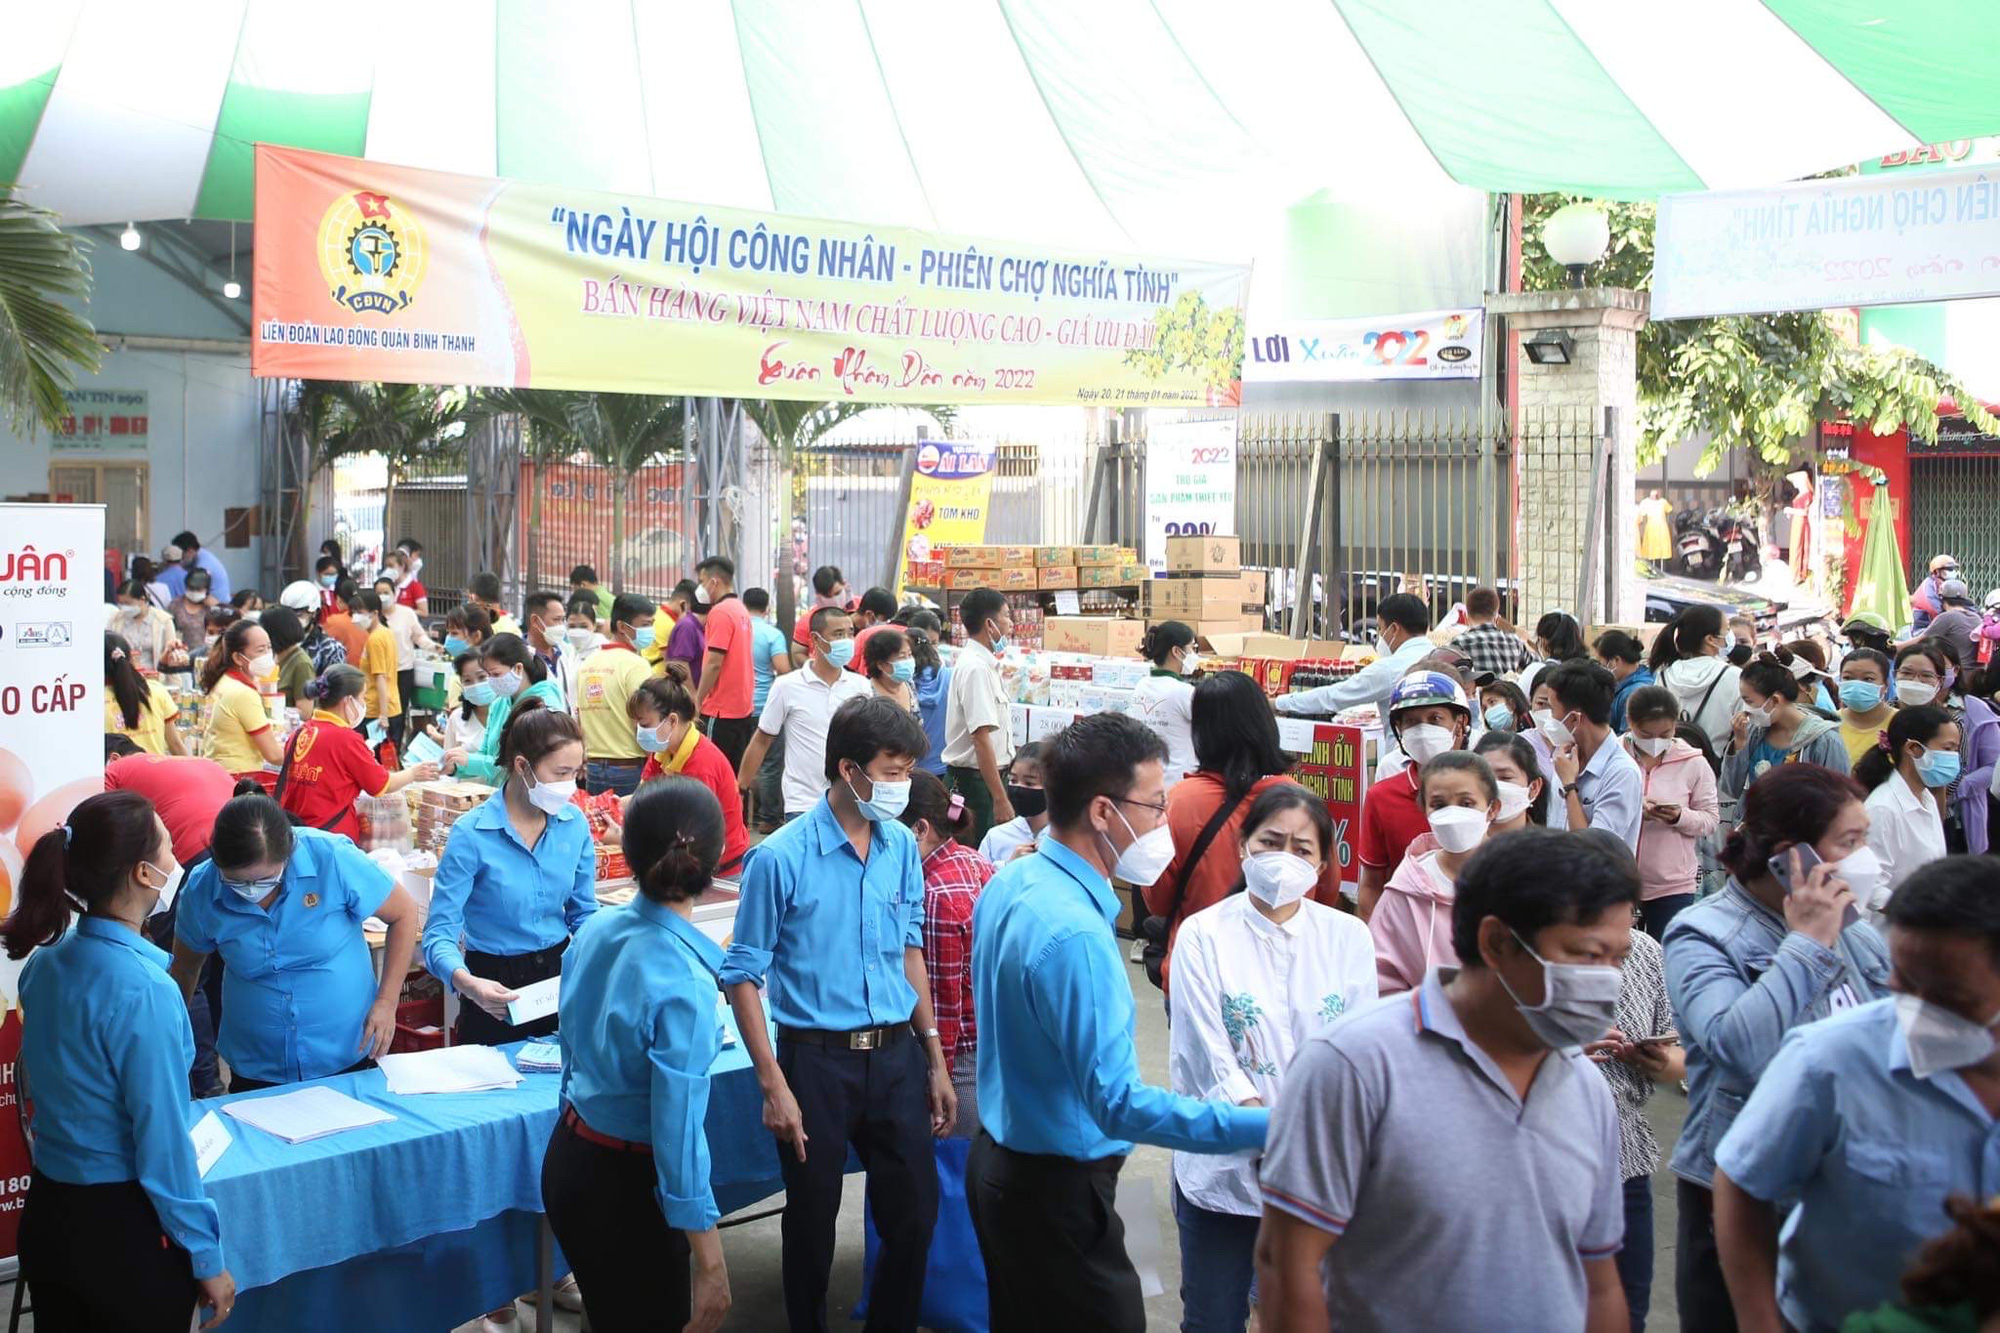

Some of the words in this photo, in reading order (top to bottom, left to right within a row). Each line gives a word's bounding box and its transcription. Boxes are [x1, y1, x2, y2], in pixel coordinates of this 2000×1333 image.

[665, 216, 718, 274] HỘI
[728, 228, 810, 273] CÔNG
[818, 234, 896, 282] NHÂN
[920, 246, 993, 291] PHIÊN
[1000, 259, 1049, 306] CHỢ
[1052, 264, 1118, 301] NGHĨA
[352, 293, 393, 311] CĐVN
[582, 274, 642, 315] BÁN
[648, 281, 728, 323] HÀNG
[736, 288, 790, 335] VIỆT
[795, 299, 852, 333] NAM
[856, 295, 918, 334] CHẤT
[921, 306, 995, 347] LƯỢNG
[1001, 315, 1041, 344] CAO
[1057, 313, 1092, 347] GIÁ
[1095, 319, 1121, 348] ƯU
[261, 320, 285, 341] LIÊN
[323, 328, 344, 345] LAO
[441, 334, 475, 355] THẠNH
[1363, 330, 1431, 366] 2022
[952, 368, 987, 392] năm
[994, 368, 1035, 390] 2022
[32, 673, 86, 714] CẤP
[1334, 733, 1353, 767] ỔN
[0, 1062, 15, 1084] H
[0, 1197, 25, 1211] w.b
